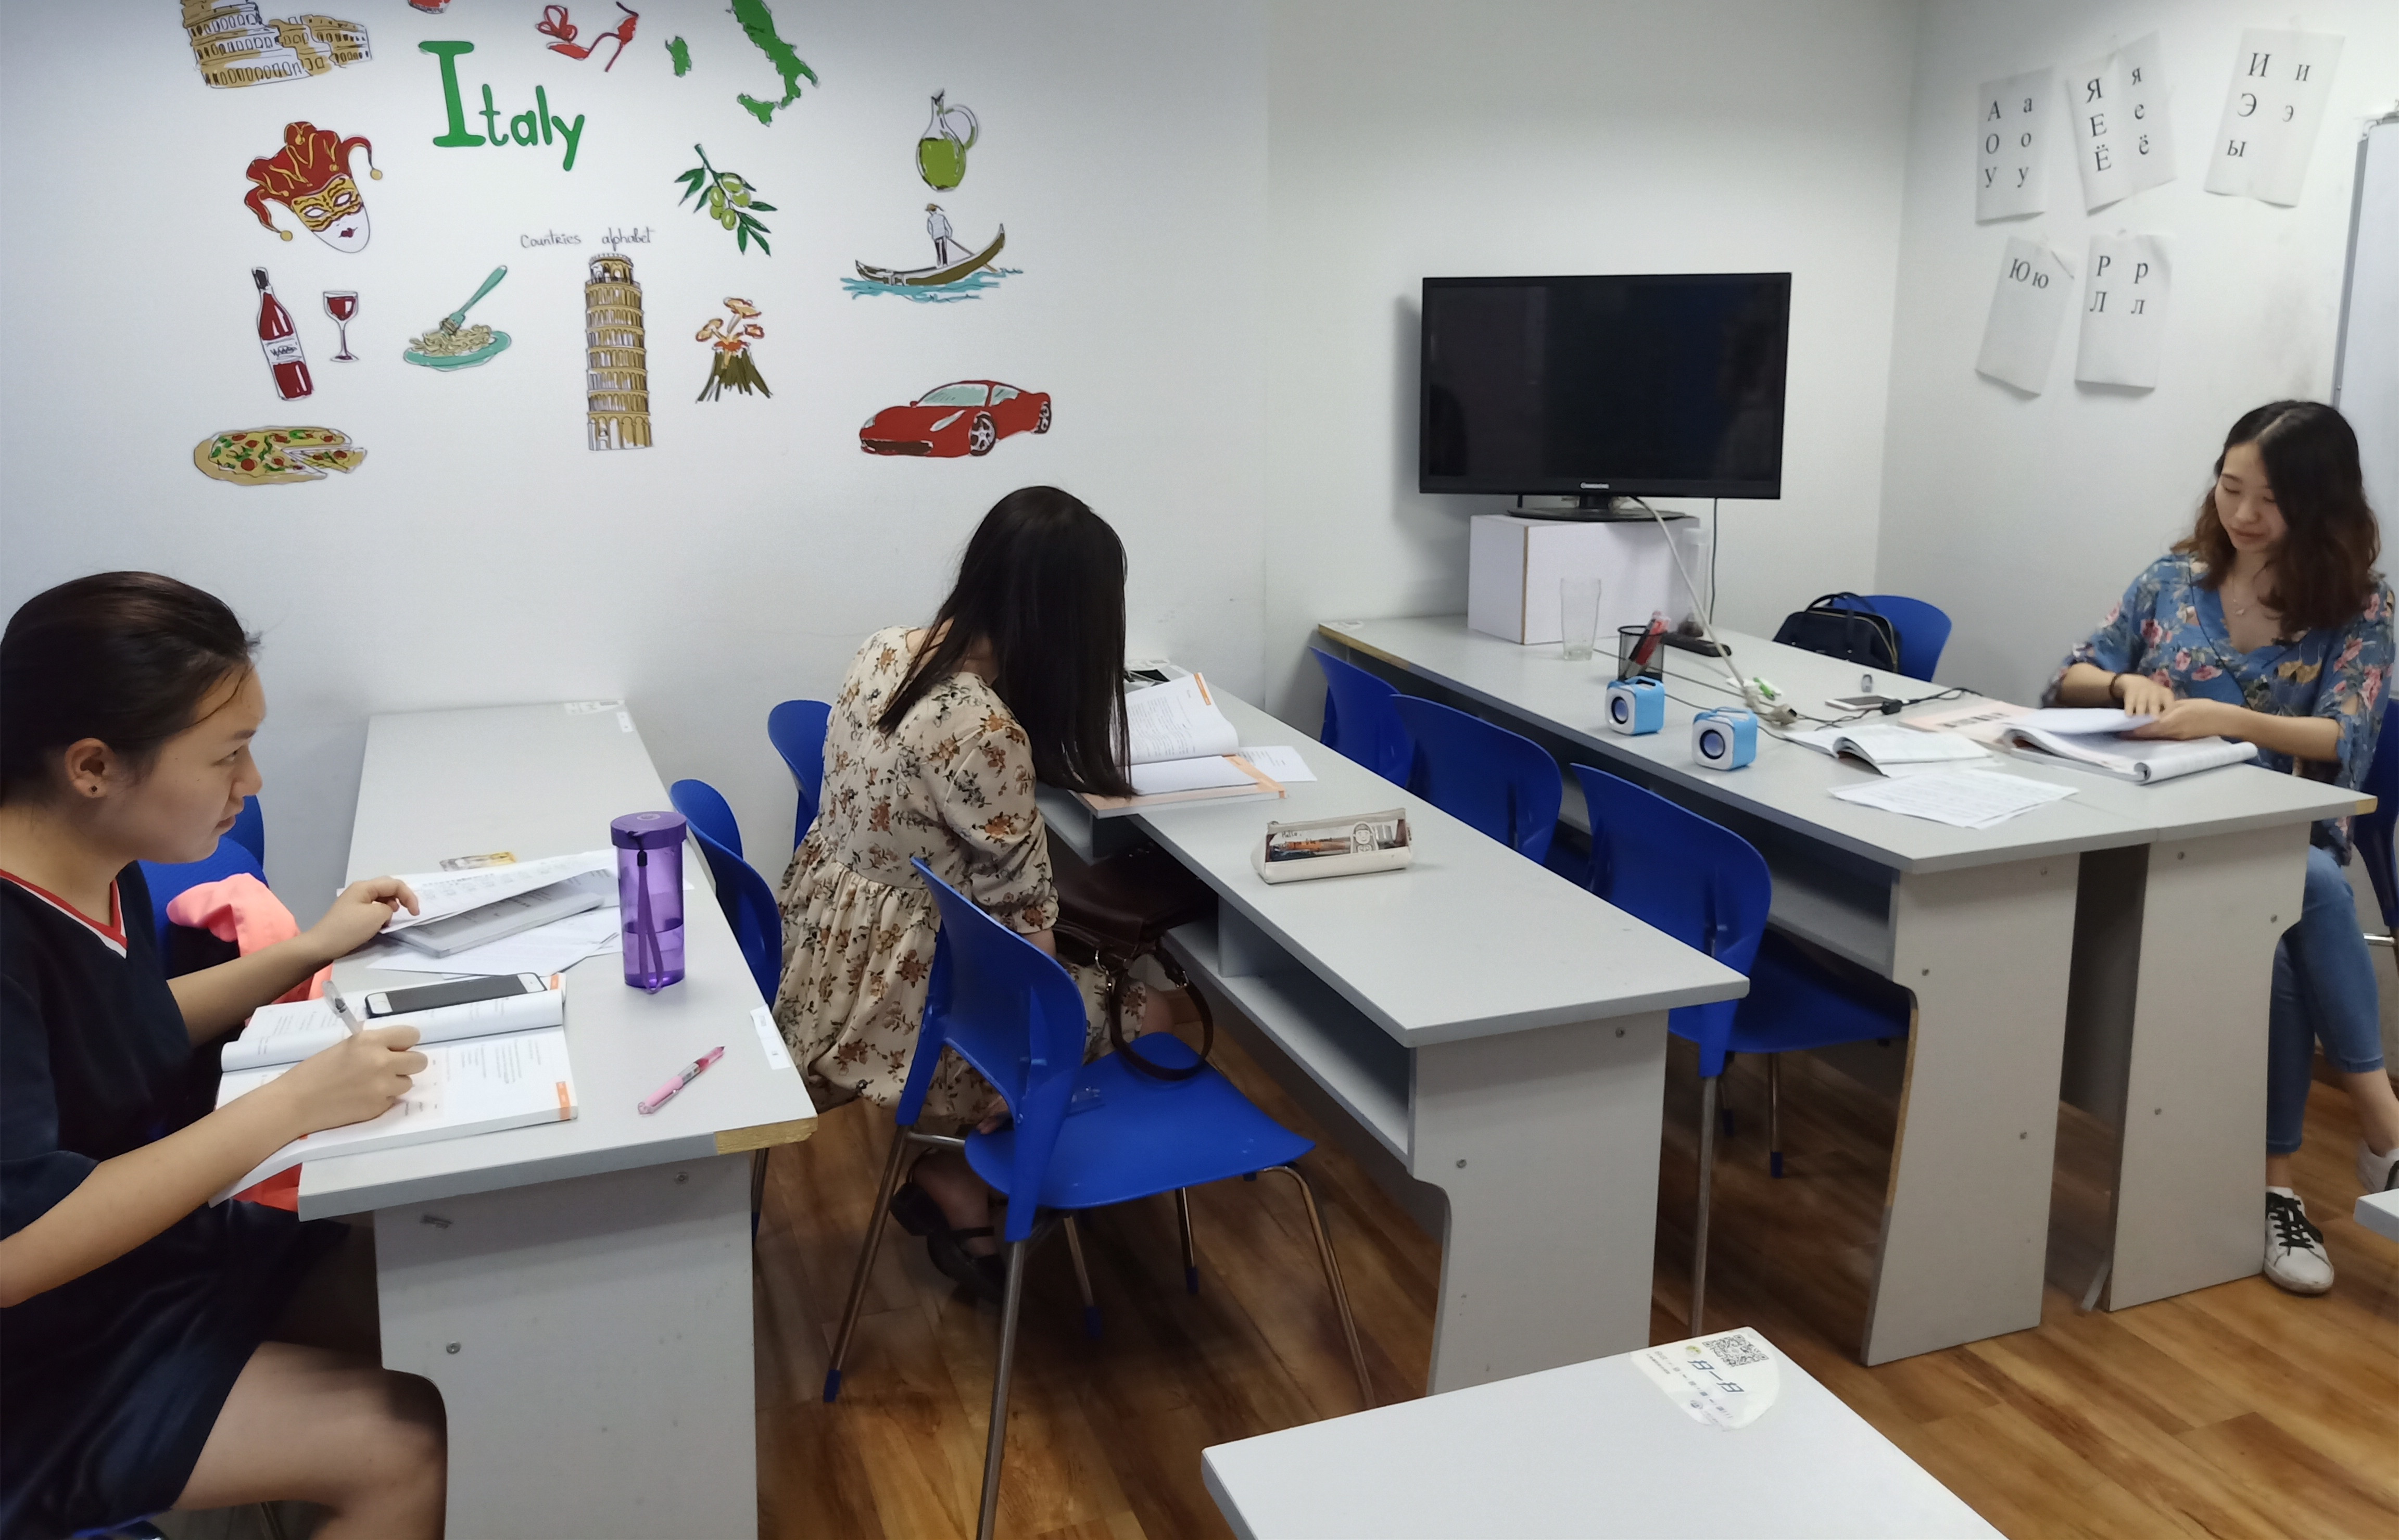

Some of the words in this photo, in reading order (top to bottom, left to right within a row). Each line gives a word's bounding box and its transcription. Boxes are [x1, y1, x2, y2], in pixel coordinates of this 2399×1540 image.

[2248, 53, 2271, 78] И
[2295, 64, 2311, 82] и
[2086, 78, 2103, 104] Я
[2131, 67, 2142, 85] я
[418, 41, 585, 172] Italy
[1987, 100, 2002, 121] А
[2238, 93, 2257, 117] Э
[2282, 105, 2295, 122] э
[2089, 113, 2107, 137] Е
[2094, 144, 2112, 172] Ё
[2138, 134, 2150, 155] ё
[520, 229, 582, 249] Countries
[601, 227, 655, 251] alphabet
[2097, 255, 2112, 277] Р
[2134, 262, 2149, 284] р
[2089, 291, 2107, 313] Л
[2130, 299, 2146, 314] л
